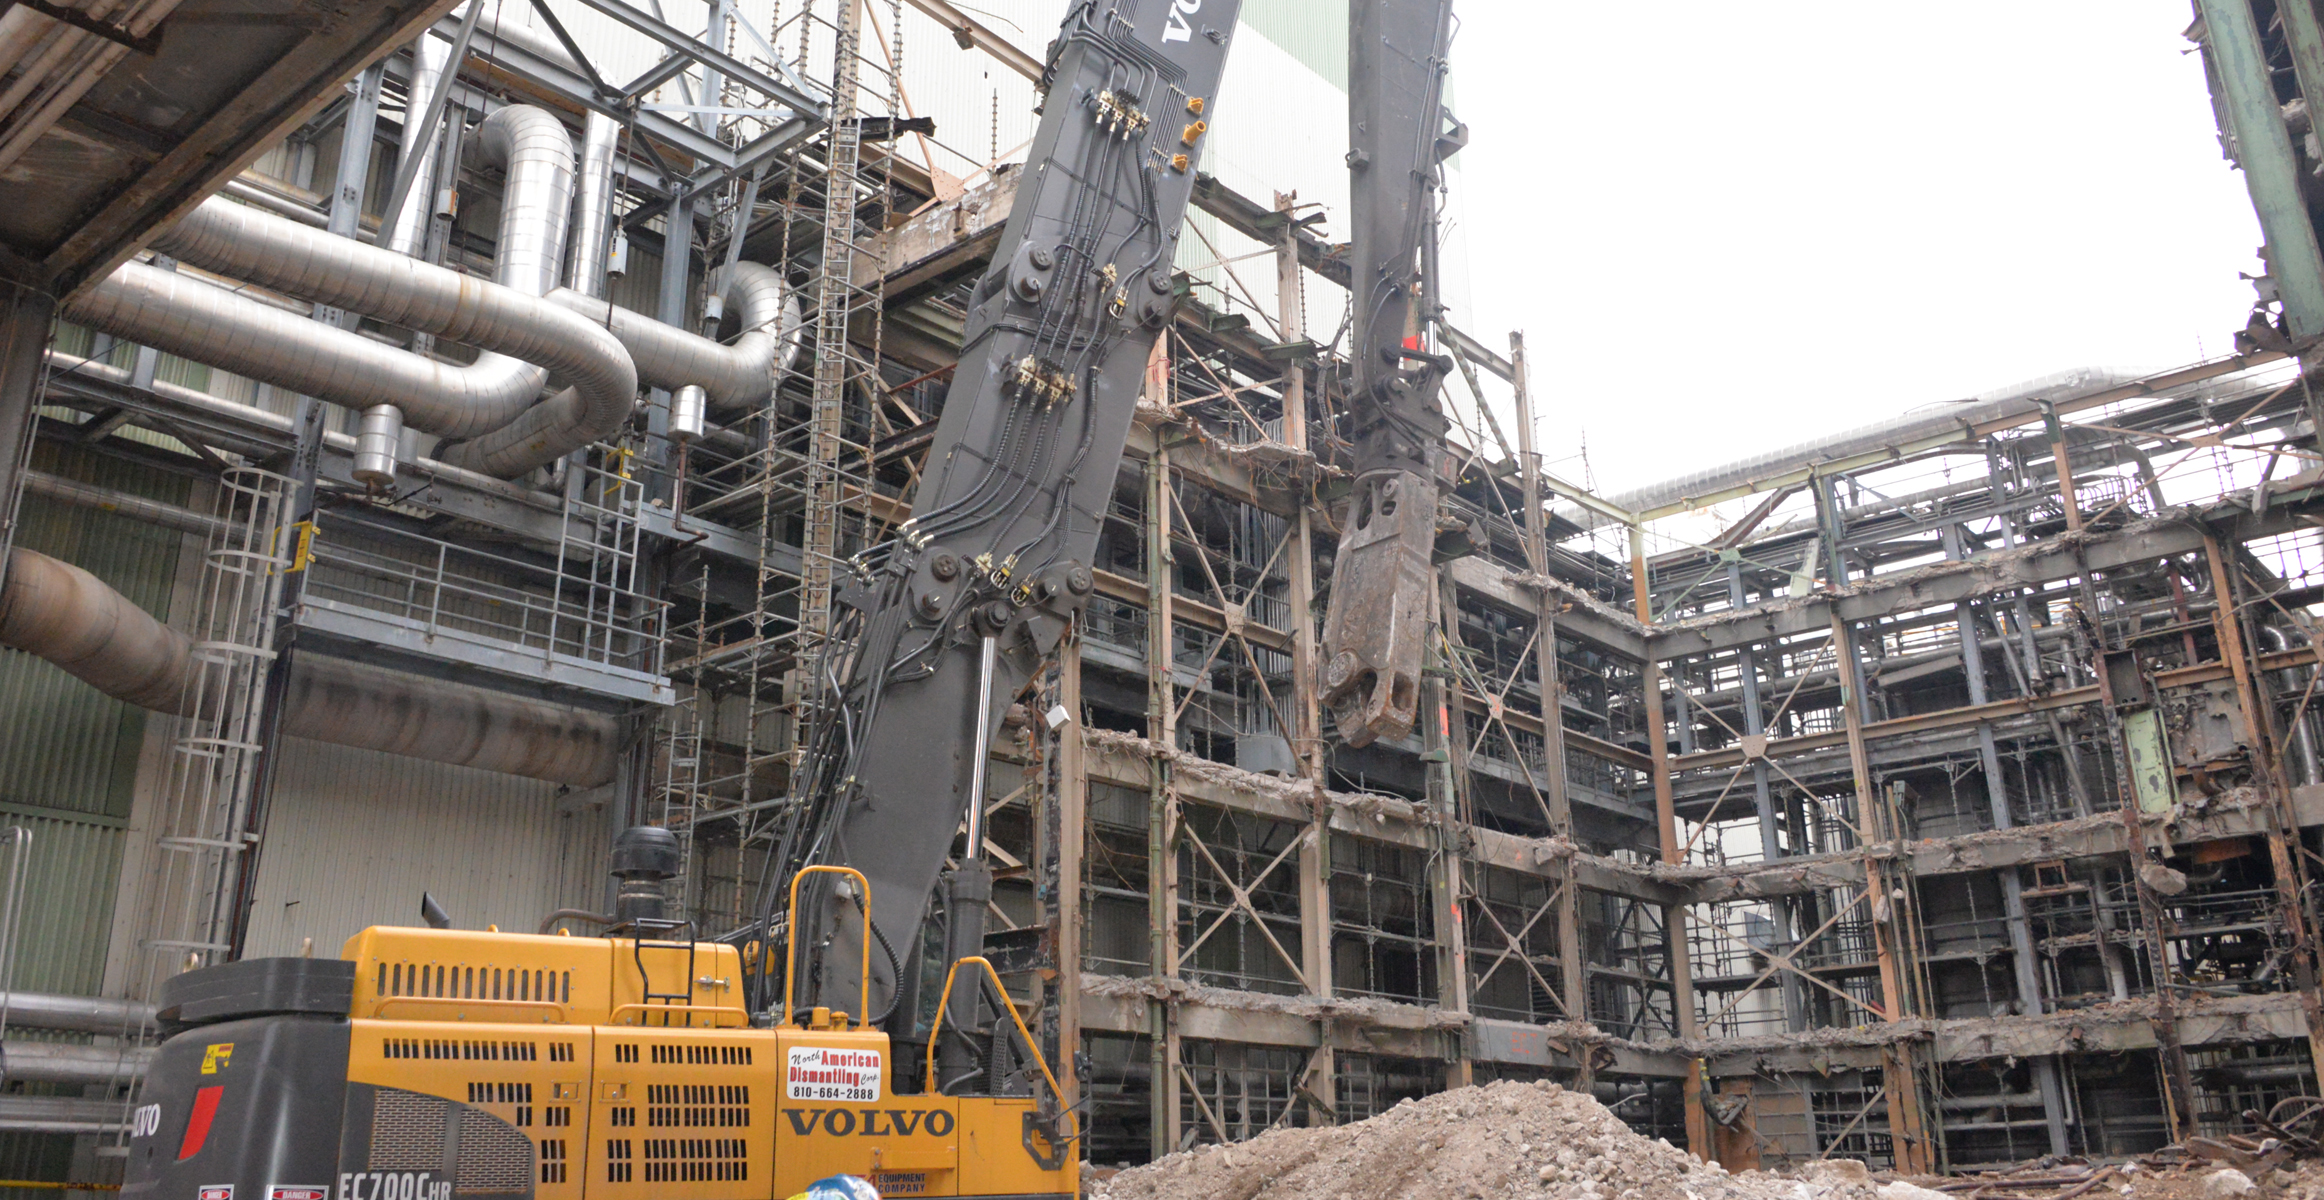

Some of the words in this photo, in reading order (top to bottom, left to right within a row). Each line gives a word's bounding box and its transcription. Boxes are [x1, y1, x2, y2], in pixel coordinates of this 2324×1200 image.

[791, 1050, 821, 1065] North
[821, 1051, 879, 1067] American
[789, 1066, 860, 1087] Dismantling
[860, 1073, 879, 1085] Corp.
[793, 1086, 874, 1100] 810-664-2888
[781, 1108, 955, 1137] VOLVO
[878, 1173, 925, 1183] EQUIPMENT
[282, 1190, 311, 1200] DANGER
[878, 1184, 925, 1194] COMPANY
